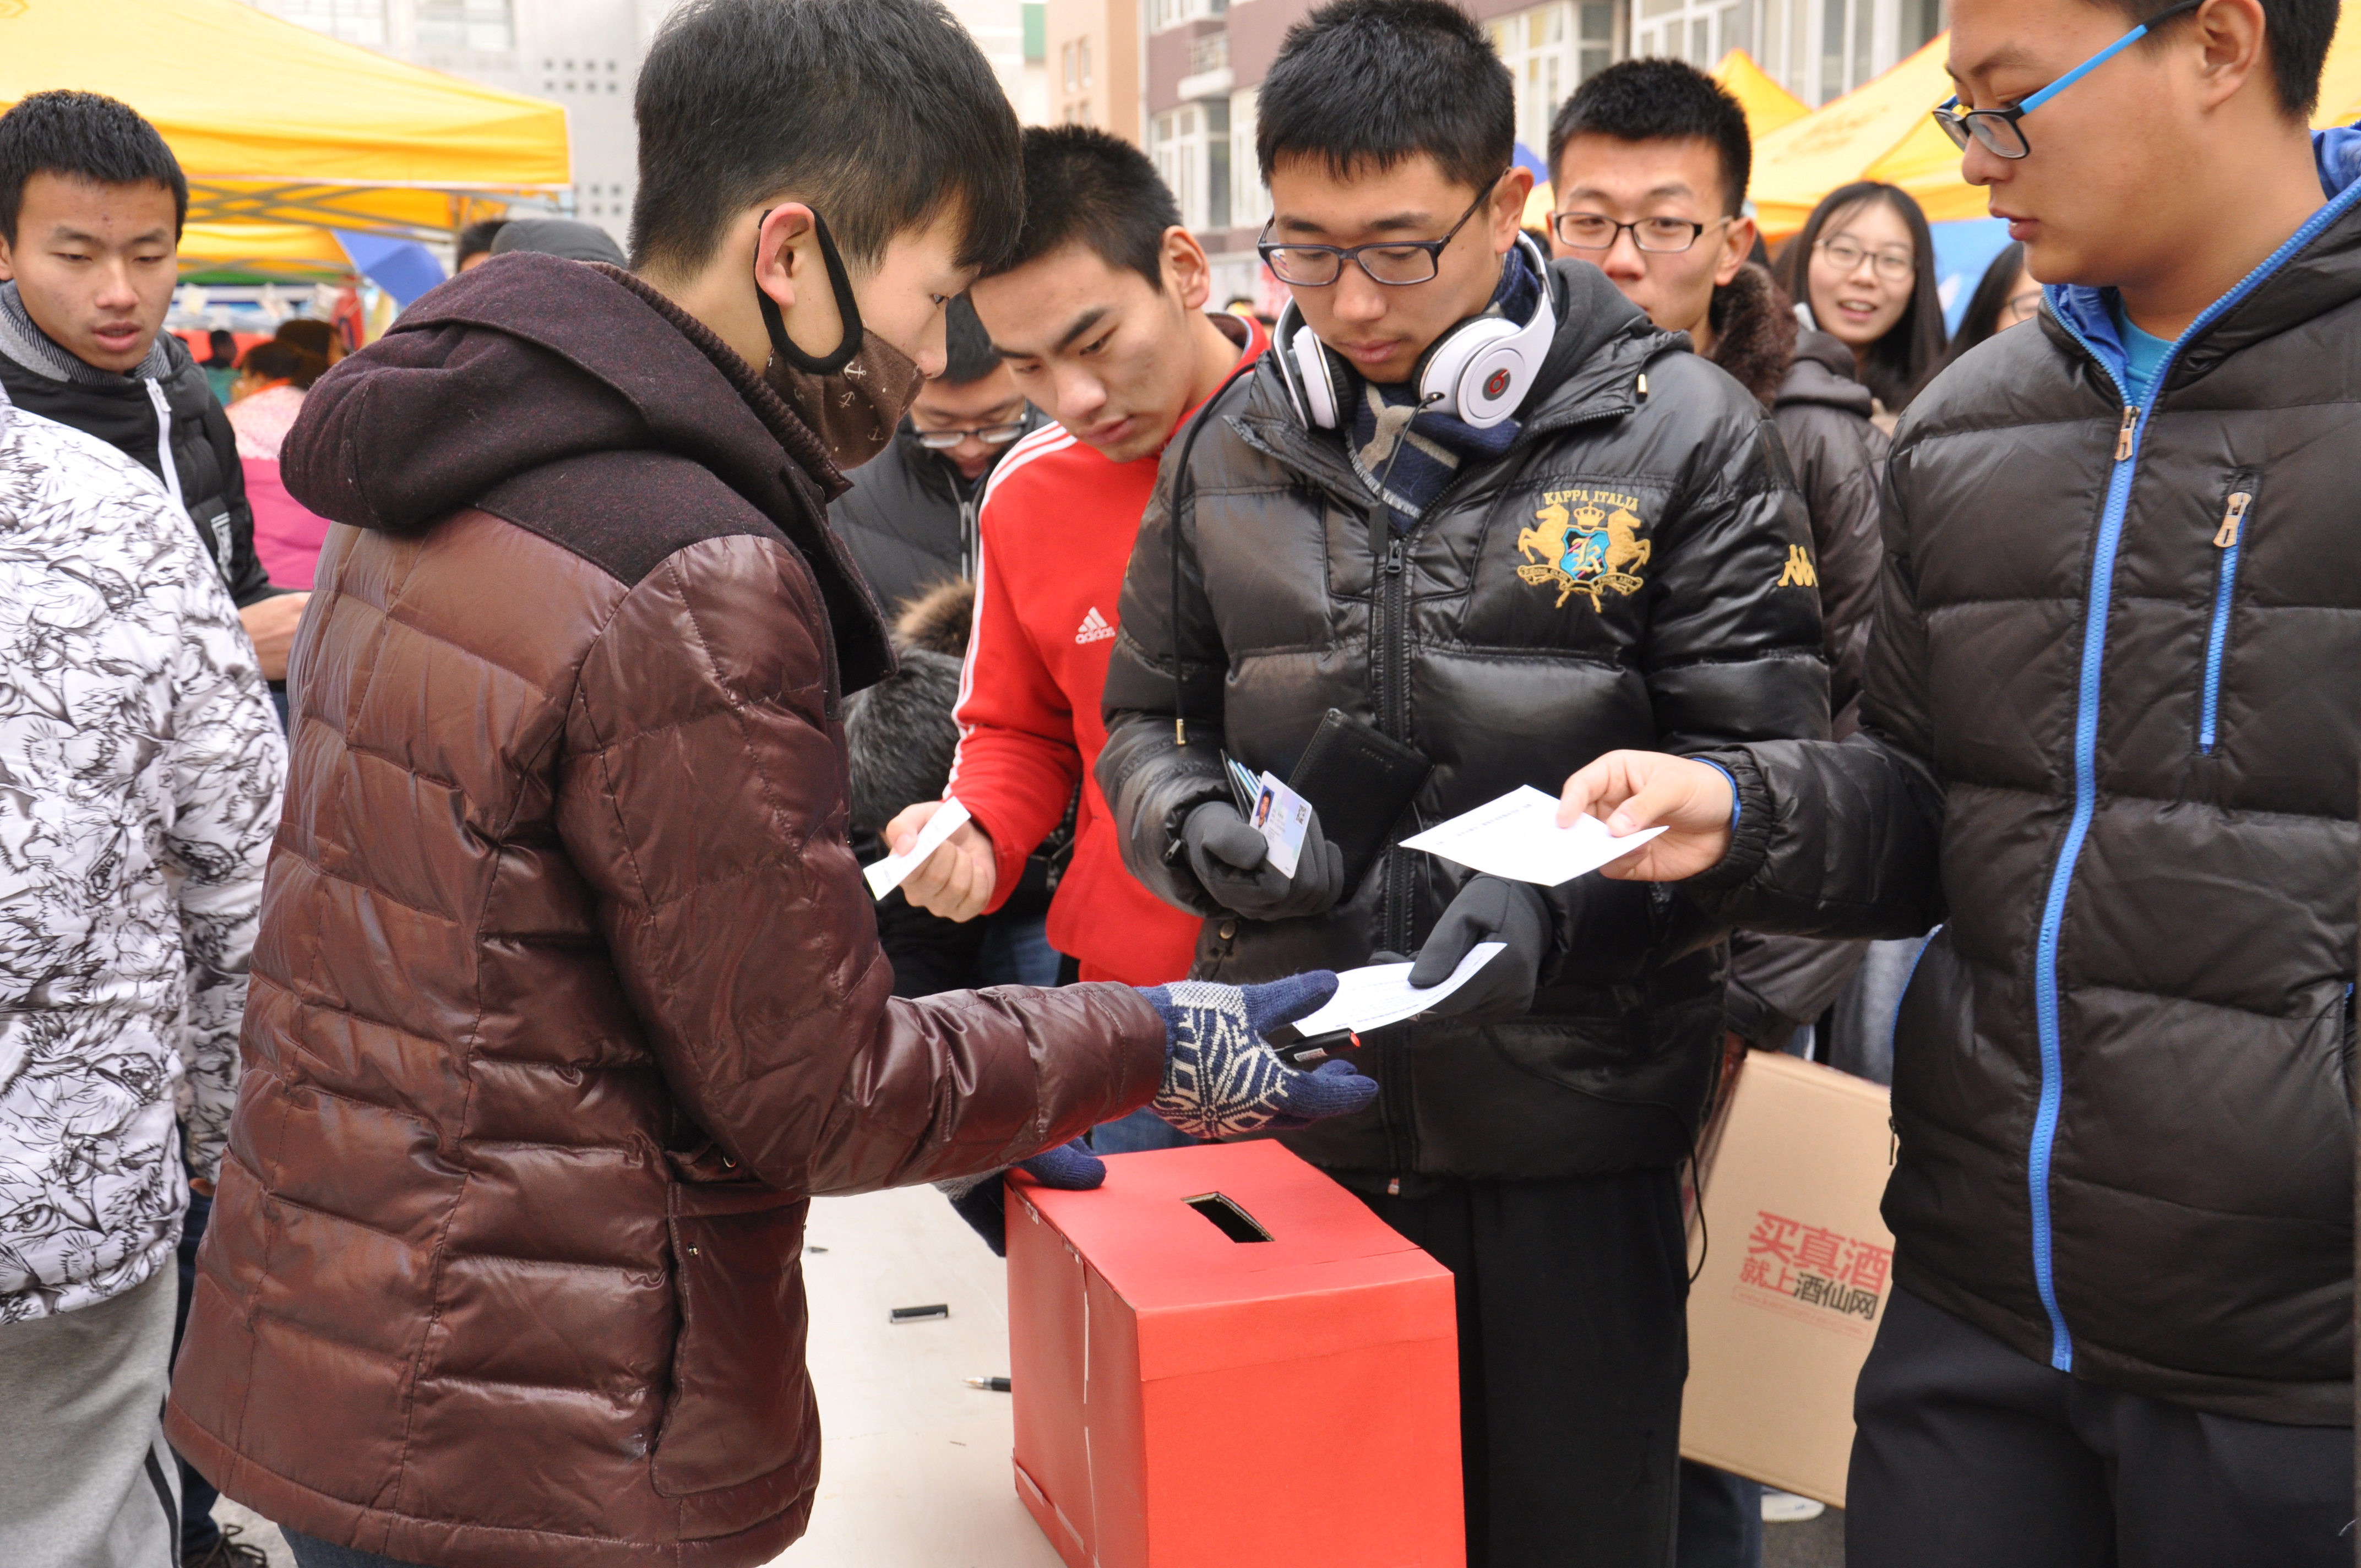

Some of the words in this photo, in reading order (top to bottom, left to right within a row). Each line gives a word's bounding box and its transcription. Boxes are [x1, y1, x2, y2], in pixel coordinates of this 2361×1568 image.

[1543, 489, 1588, 505] KAPPA
[1593, 491, 1639, 511] ITALIA
[1748, 1211, 1894, 1294] 买真酒
[1740, 1256, 1879, 1320] 就上酒仙网
